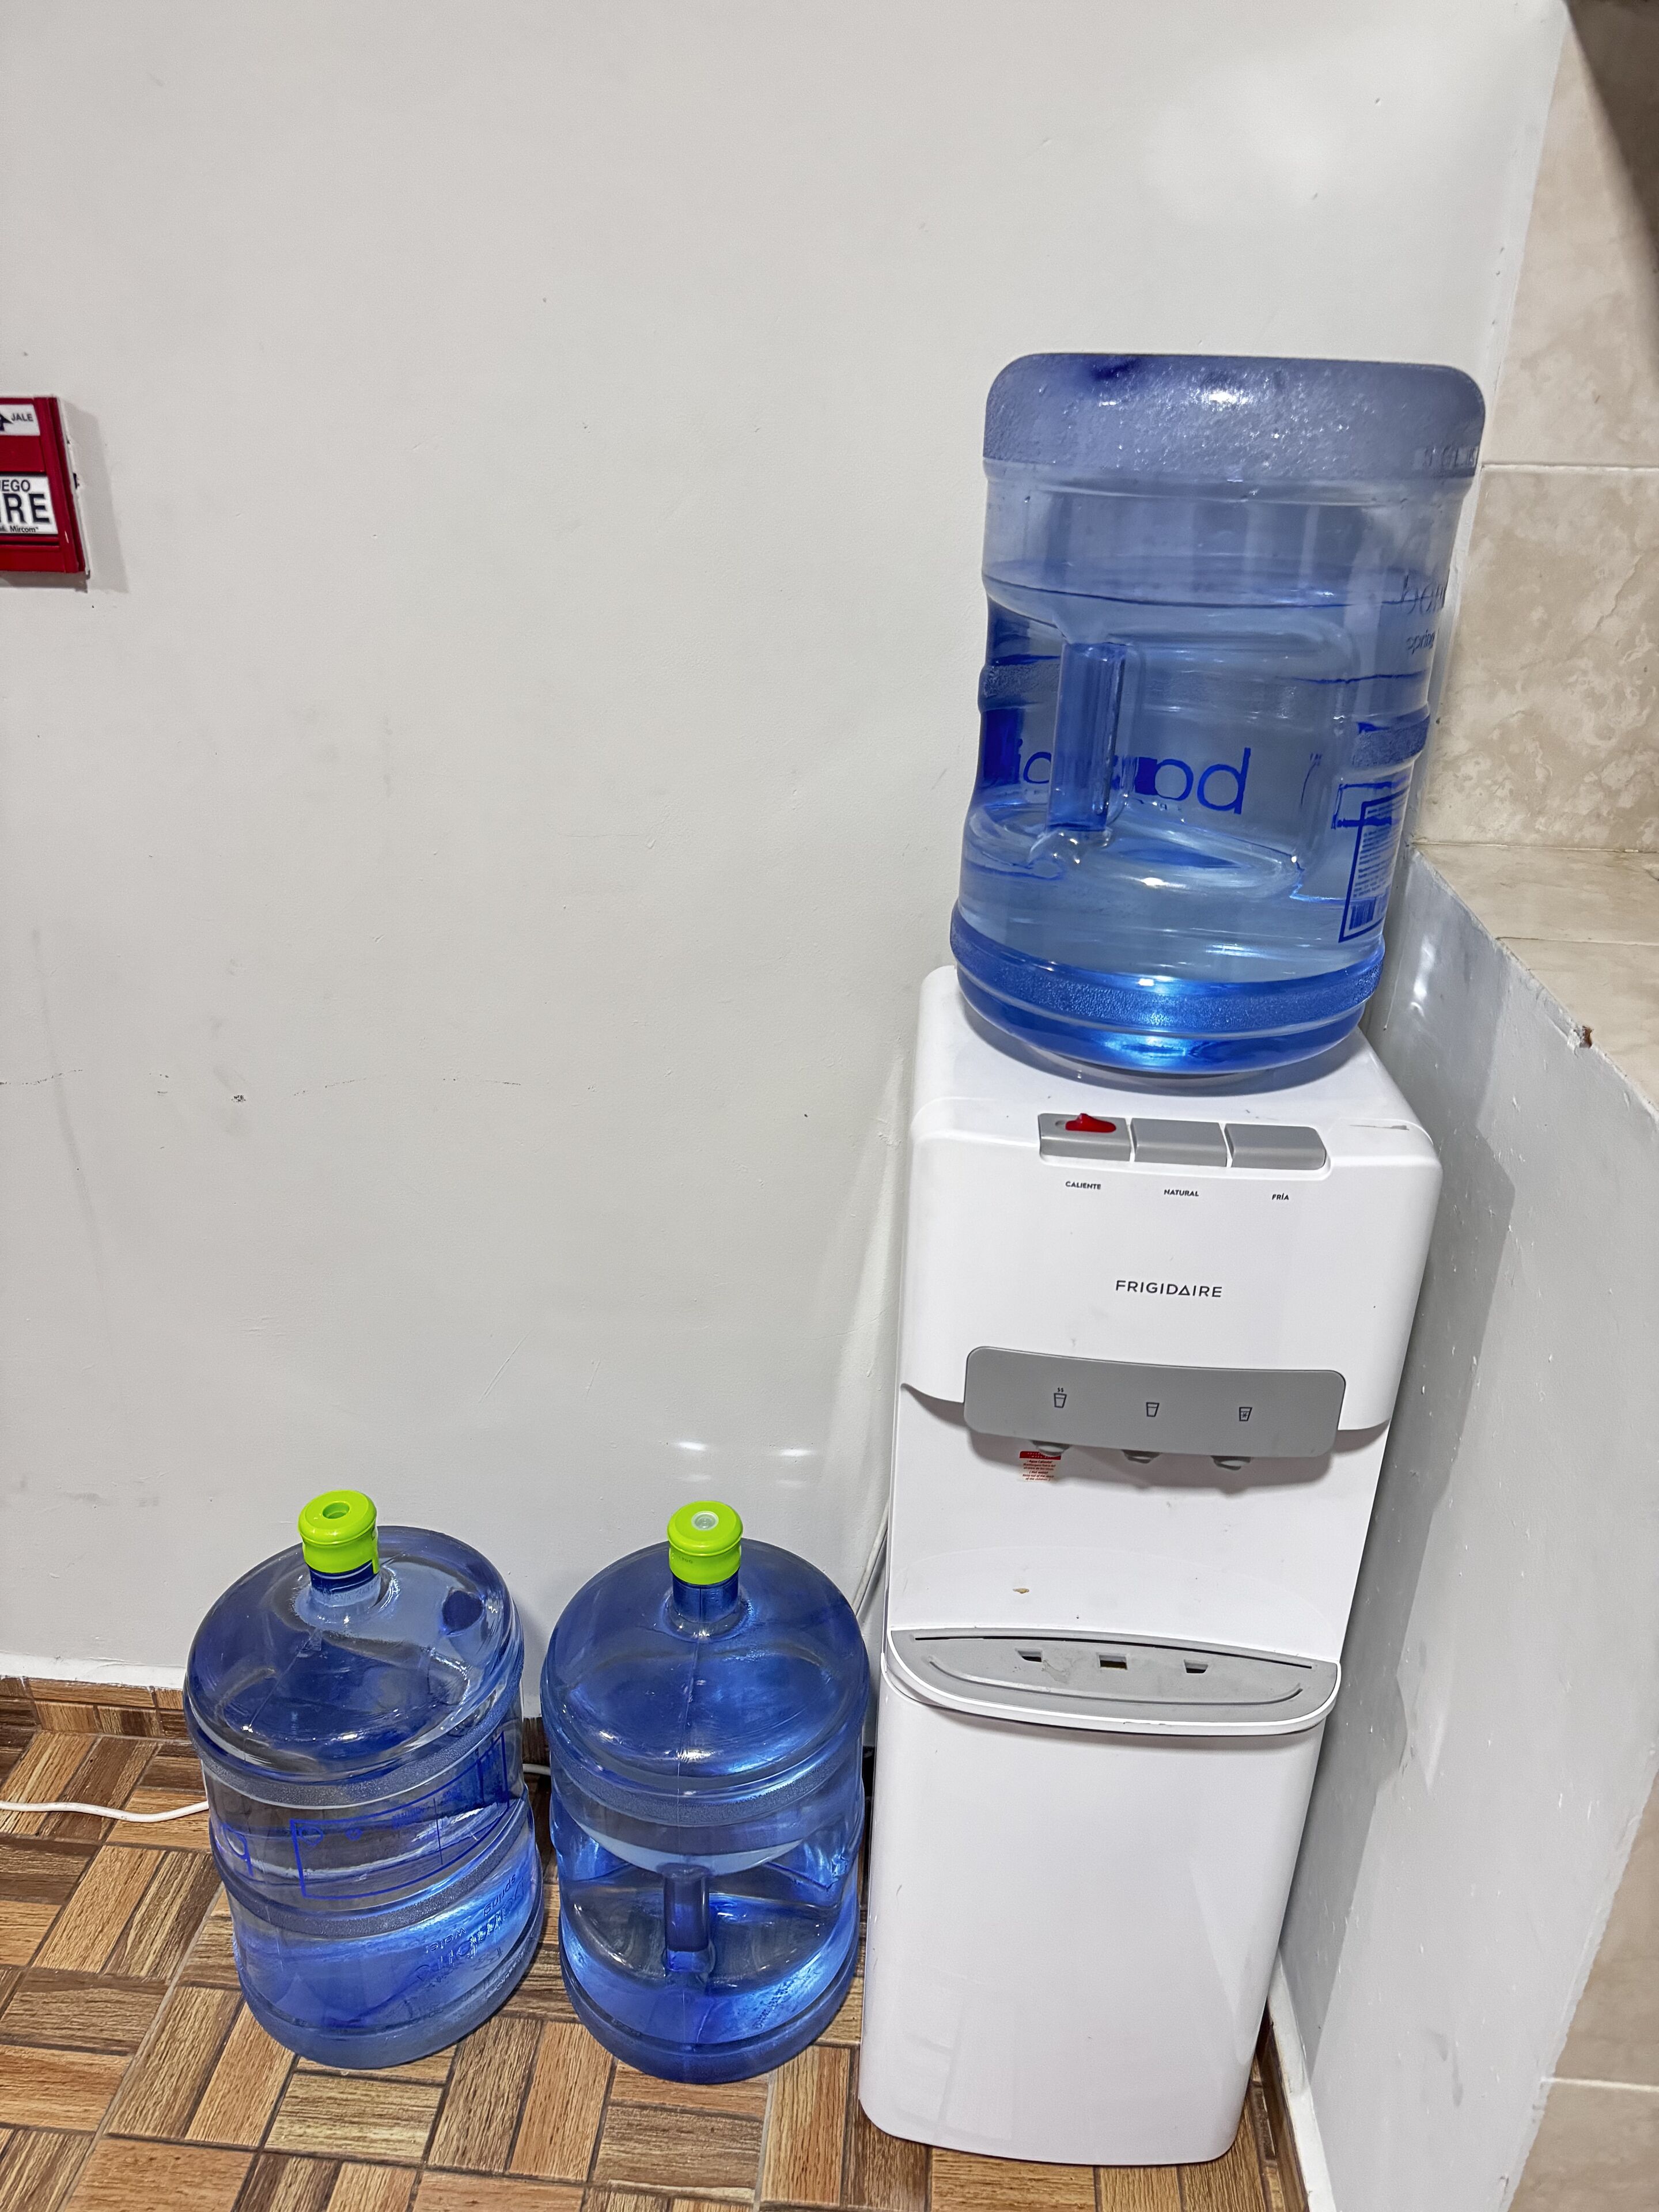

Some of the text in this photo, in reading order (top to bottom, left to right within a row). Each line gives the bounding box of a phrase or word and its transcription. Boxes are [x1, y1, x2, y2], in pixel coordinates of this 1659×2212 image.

[11, 413, 33, 422] JALE
[0, 479, 31, 492] EGO
[0, 493, 51, 524] RE
[1065, 1180, 1101, 1191] CALIENTE
[1164, 1188, 1199, 1198] NATURAL
[1271, 1192, 1290, 1201] FRÍA
[1115, 1279, 1223, 1298] FRIGIDAIRE
[483, 1873, 517, 1917] spring
